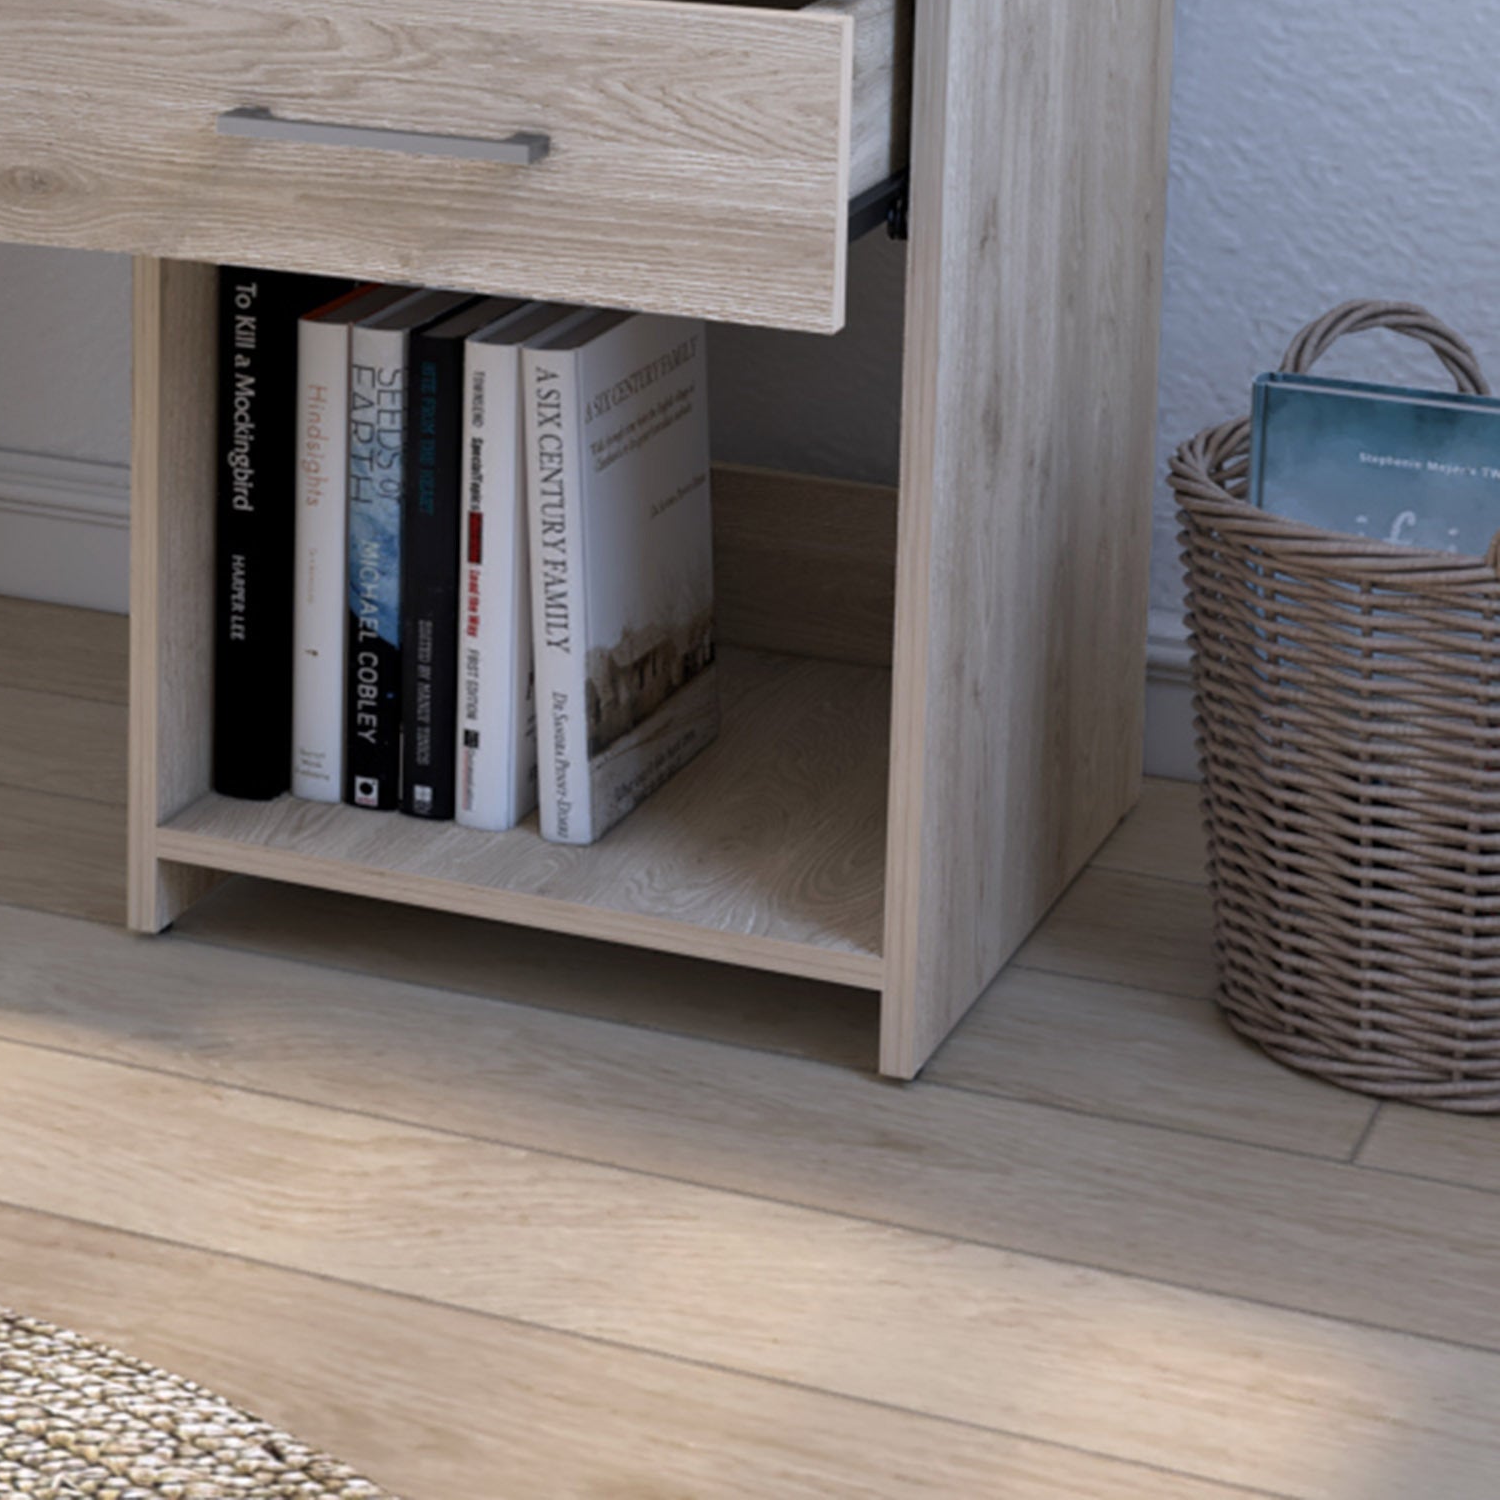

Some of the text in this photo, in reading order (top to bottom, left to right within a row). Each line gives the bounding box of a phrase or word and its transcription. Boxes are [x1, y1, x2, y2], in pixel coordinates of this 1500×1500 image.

[227, 282, 257, 511] To Kill a Mockingbird
[301, 383, 329, 508] Hindsights
[350, 363, 376, 505] EARTH
[376, 367, 403, 471] SEEDS
[535, 366, 571, 654] A SIX CENTURY FAMILY
[229, 554, 246, 641] HARPER LEE
[357, 539, 381, 745] MICHAEL COBLEY
[465, 678, 480, 721] EDITION
[467, 647, 480, 678] FIRST
